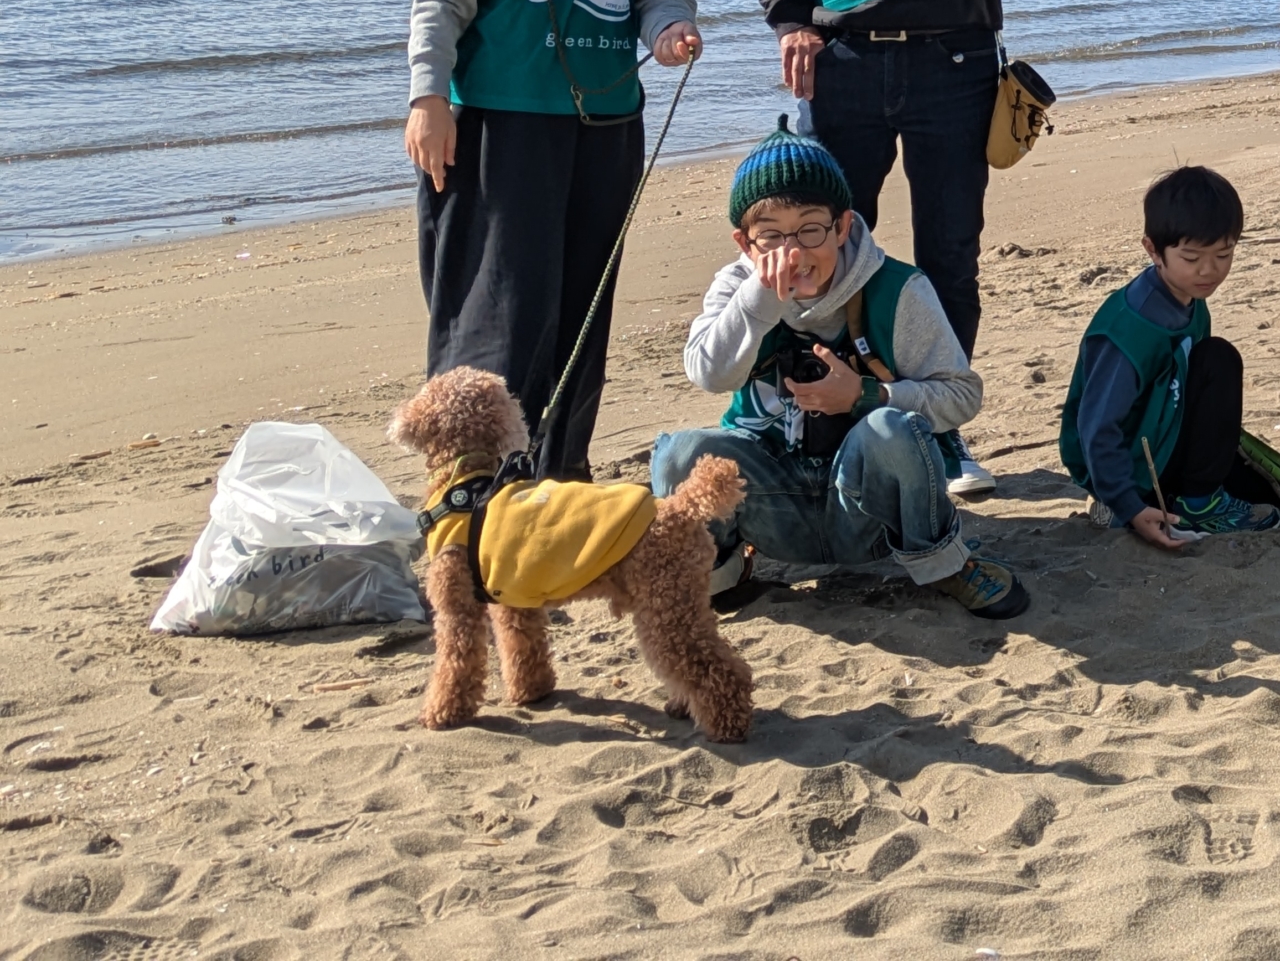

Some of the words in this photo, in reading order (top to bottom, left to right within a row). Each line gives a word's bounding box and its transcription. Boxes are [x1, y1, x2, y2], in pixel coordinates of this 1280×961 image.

[545, 33, 593, 48] geen
[598, 35, 631, 50] bird
[271, 544, 325, 576] bird
